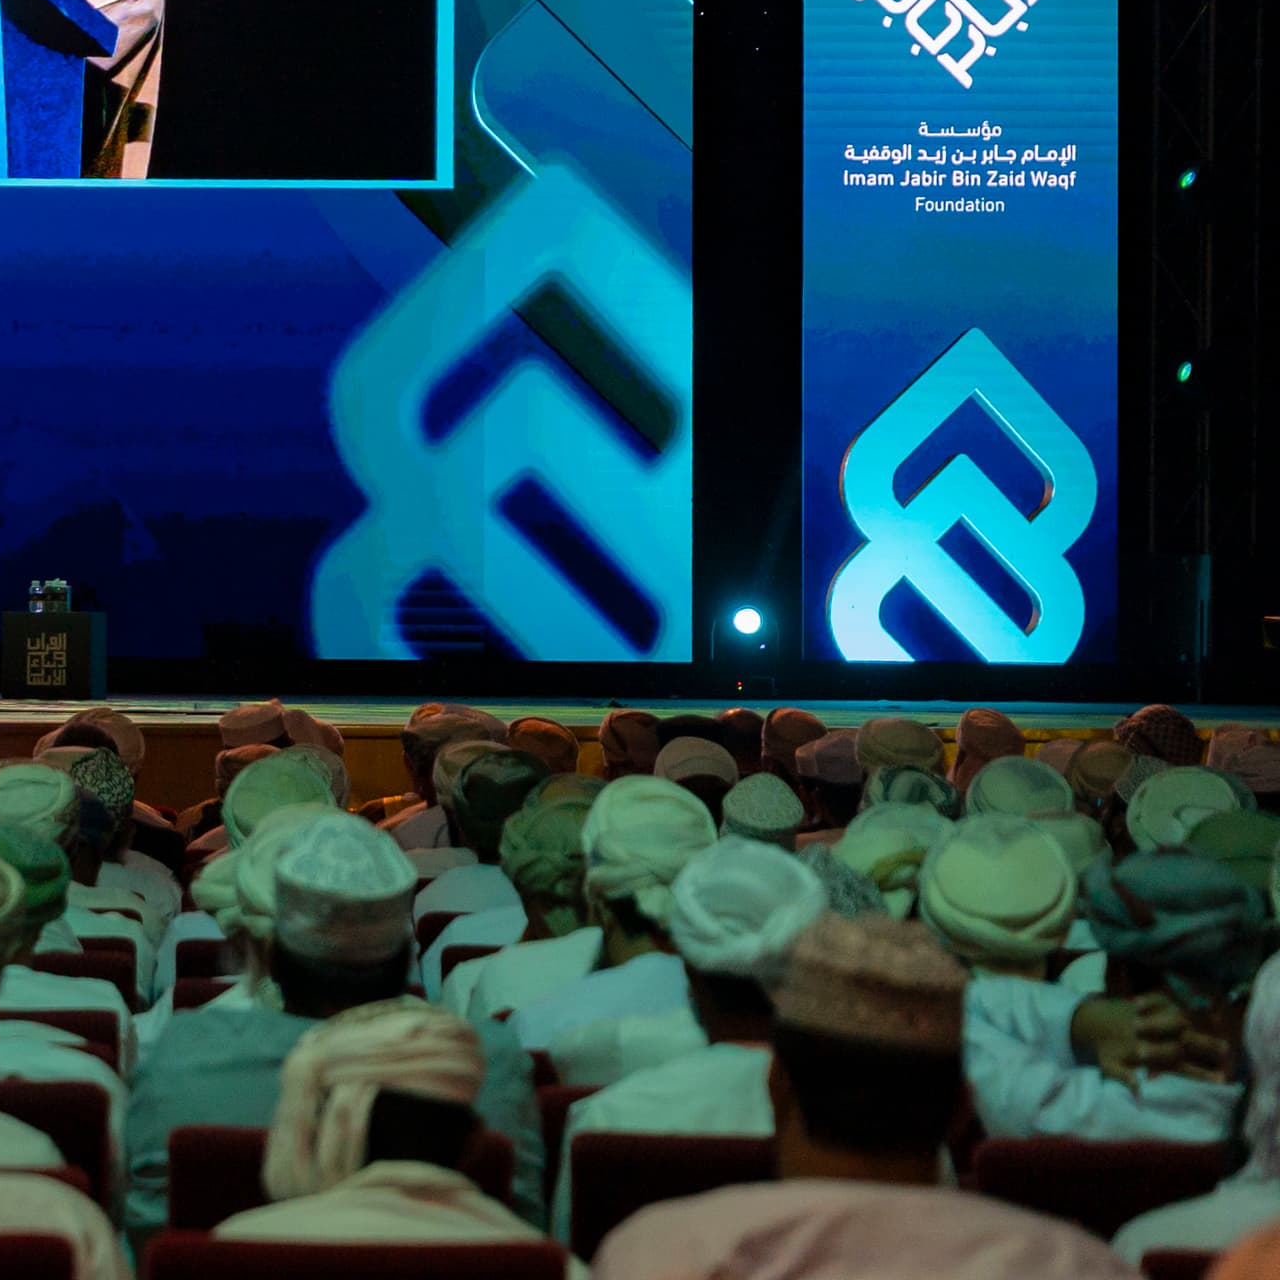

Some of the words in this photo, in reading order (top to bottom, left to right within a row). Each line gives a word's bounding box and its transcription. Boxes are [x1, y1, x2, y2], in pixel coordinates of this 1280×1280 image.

[918, 121, 1002, 141] مؤسسة
[844, 144, 912, 165] الوقفية
[917, 145, 947, 165] زيد
[951, 148, 977, 165] بن
[981, 144, 1017, 165] جابر
[1020, 144, 1077, 167] الإمام
[843, 169, 895, 187] Imam
[899, 169, 947, 187] Jabir
[951, 170, 981, 187] Bin
[986, 170, 1025, 187] Zaid
[1030, 170, 1077, 191] Waqf
[915, 196, 1005, 212] Foundation
